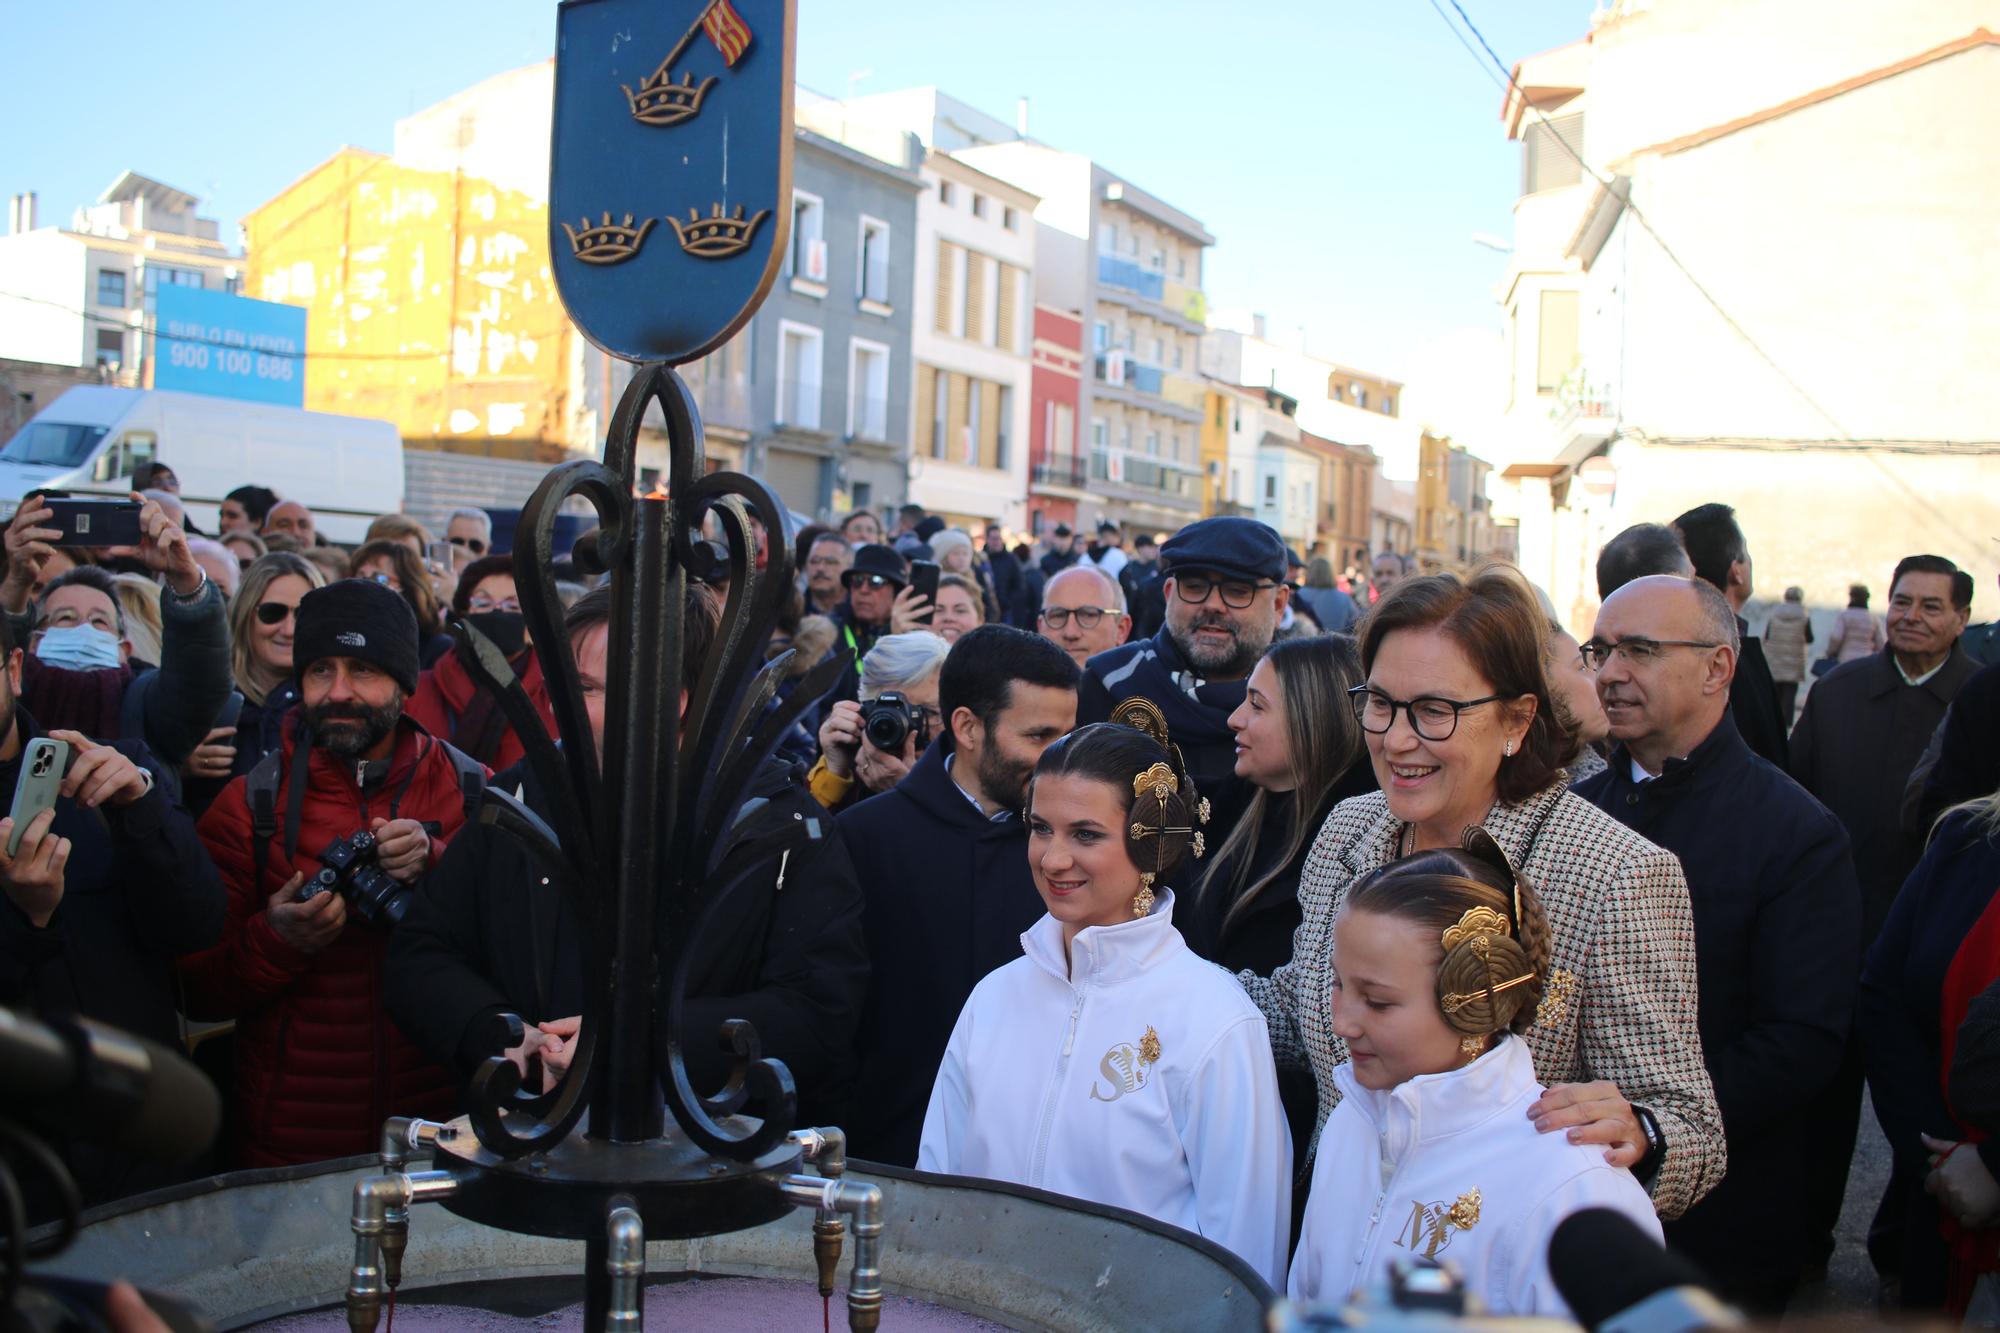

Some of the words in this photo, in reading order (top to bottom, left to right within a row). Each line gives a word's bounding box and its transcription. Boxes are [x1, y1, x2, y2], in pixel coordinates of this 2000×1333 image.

[224, 329, 246, 349] EN
[249, 334, 297, 355] VENTA
[170, 341, 209, 369] 900
[216, 348, 252, 376] 100
